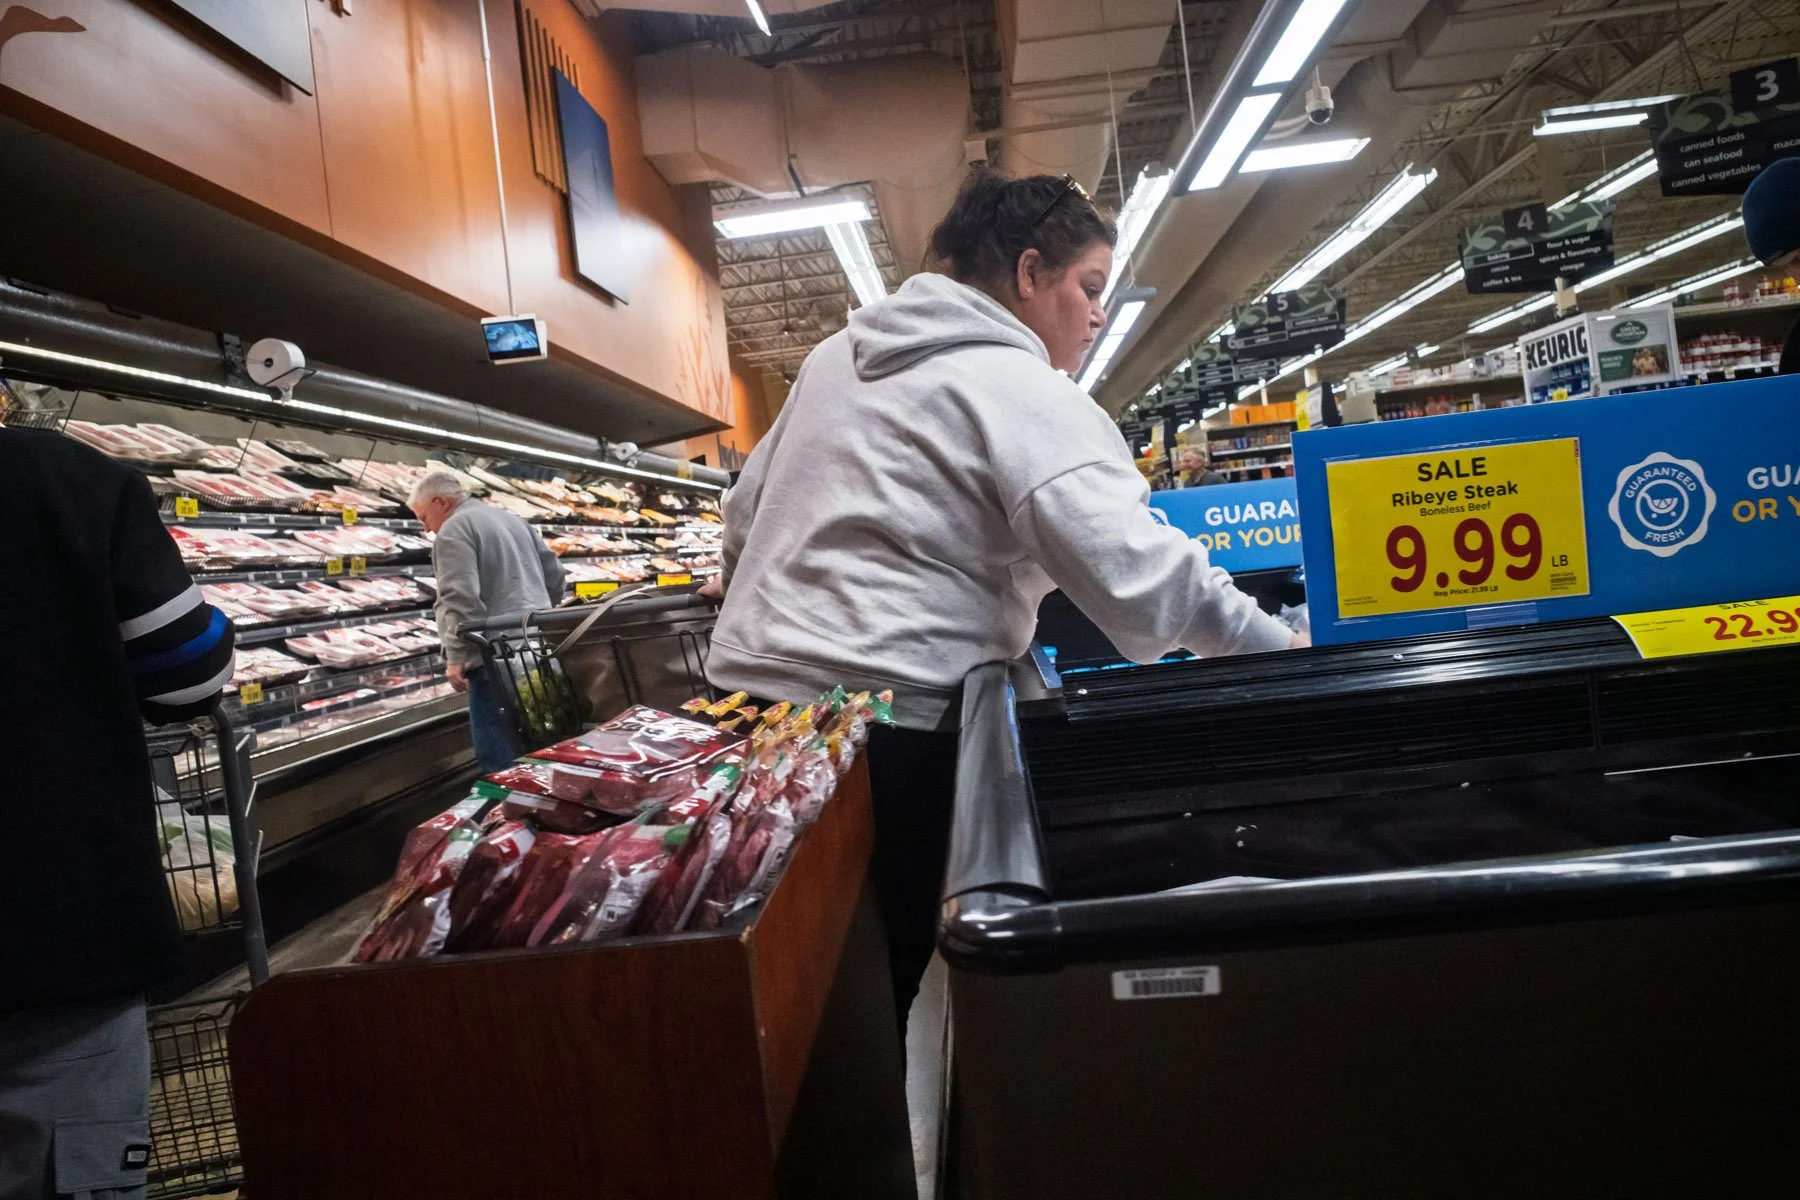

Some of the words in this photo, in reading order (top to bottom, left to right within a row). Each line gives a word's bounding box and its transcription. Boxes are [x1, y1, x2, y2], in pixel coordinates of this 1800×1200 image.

[1755, 69, 1779, 102] 3
[1680, 138, 1715, 153] canned
[1717, 132, 1745, 145] foods
[1684, 158, 1701, 168] can
[1703, 148, 1743, 164] seafood
[1671, 173, 1706, 188] canned
[1707, 163, 1762, 181] vegetables
[1517, 210, 1534, 230] 4
[1546, 241, 1563, 249] flour
[1571, 235, 1591, 246] sugar
[1539, 254, 1559, 264] spices
[1567, 245, 1602, 257] flavorings
[1560, 262, 1585, 272] vinegar
[1482, 279, 1502, 288] coffee
[1276, 294, 1288, 311] 5
[1525, 326, 1588, 370] KEURIG
[1417, 457, 1488, 482] SALE
[1625, 467, 1697, 498] GUARANTEED
[1391, 488, 1458, 507] Ribeye
[1464, 481, 1519, 499] Steak
[1204, 499, 1299, 526] GUARA
[1419, 505, 1466, 517] Boneless
[1468, 501, 1492, 513] Beef
[1732, 497, 1778, 522] OR
[1196, 532, 1231, 552] OR
[1644, 528, 1685, 543] FRESH
[1386, 512, 1542, 592] 9.99
[1551, 554, 1569, 568] LB
[1433, 590, 1448, 598] Reg
[1450, 588, 1470, 596] Price:
[1718, 600, 1769, 610] SALE
[1703, 607, 1800, 641] 22.9
